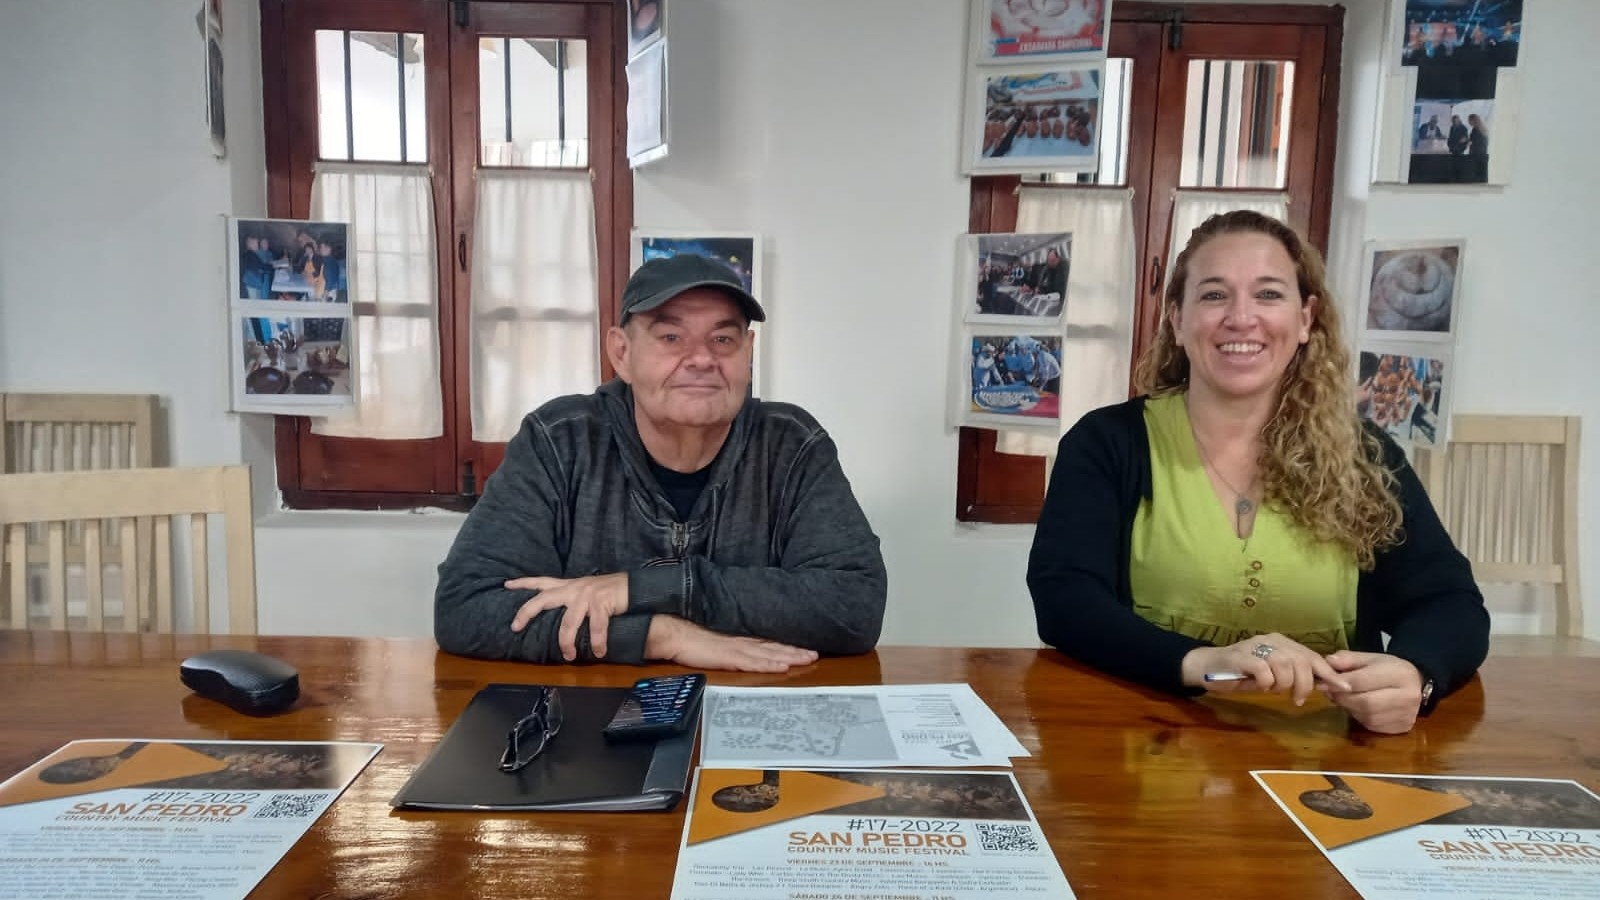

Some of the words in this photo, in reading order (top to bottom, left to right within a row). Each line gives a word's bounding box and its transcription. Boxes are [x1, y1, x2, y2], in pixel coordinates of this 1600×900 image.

[142, 791, 261, 804] #17-2022
[65, 802, 138, 815] SAN
[138, 803, 249, 817] PEDRO
[55, 814, 118, 822] COUNTRY
[123, 815, 164, 823] MUSIC
[168, 815, 234, 824] FESTIVAL
[848, 818, 963, 833] #17-2022
[788, 831, 853, 847] SAN
[862, 832, 968, 849] PEDRO
[1464, 827, 1591, 844] #17-2022
[787, 846, 852, 855] COUNTRY
[856, 847, 901, 856] MUSIC
[904, 848, 971, 857] FESTIVAL
[1418, 840, 1492, 855] SAN
[1491, 842, 1600, 859] PEDRO
[856, 859, 914, 867] SEPTIEMBRE
[1429, 853, 1497, 861] COUNTRY
